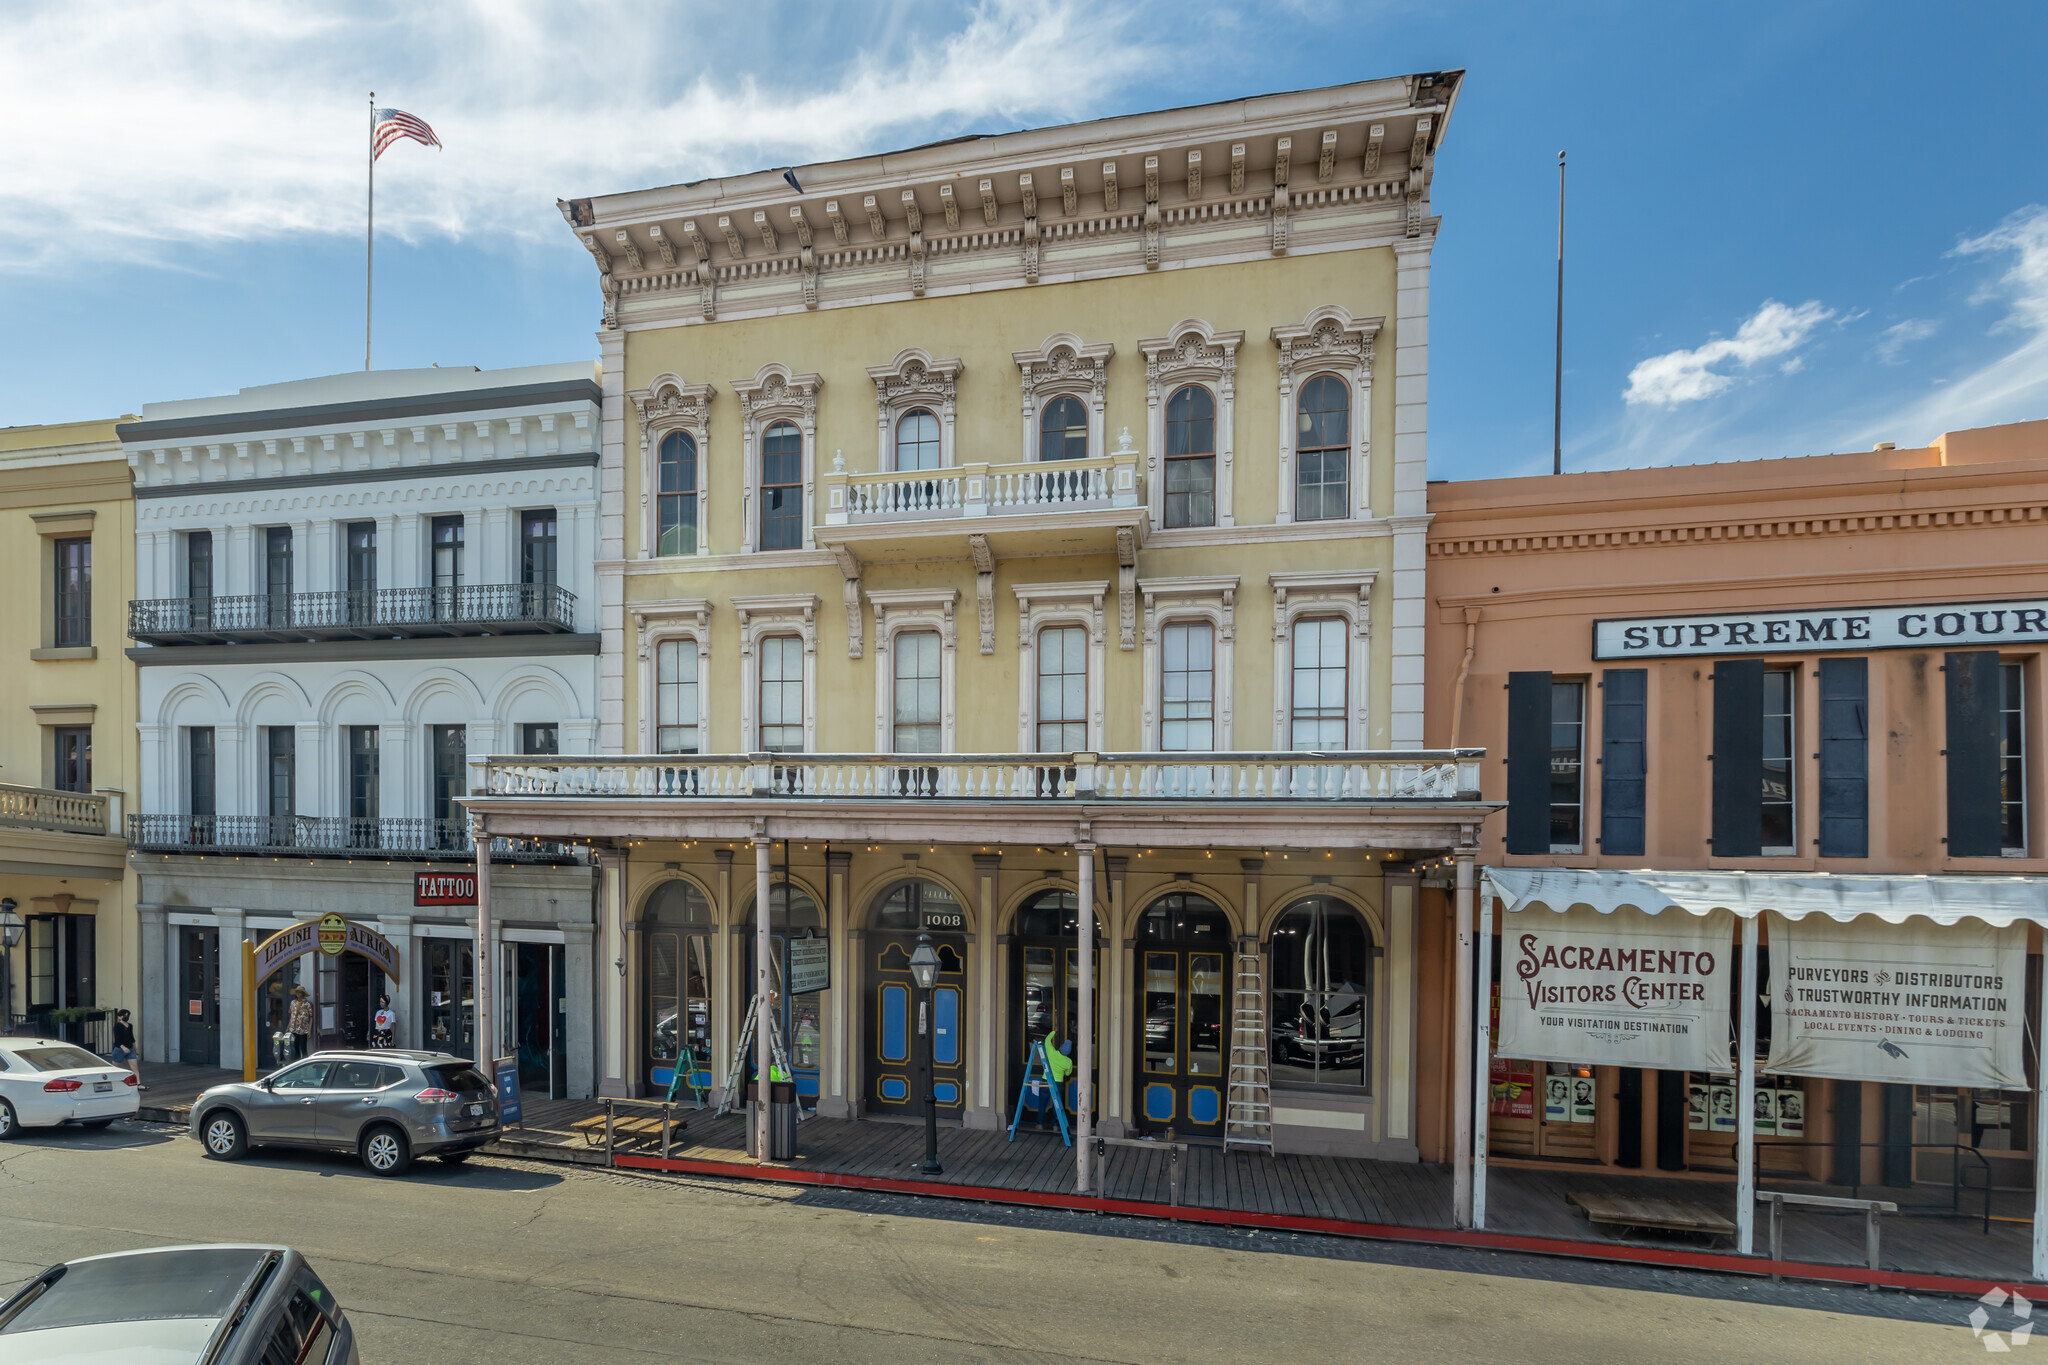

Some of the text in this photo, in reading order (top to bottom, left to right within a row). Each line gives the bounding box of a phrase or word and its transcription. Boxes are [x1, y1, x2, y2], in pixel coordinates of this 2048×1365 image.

[1623, 615, 1870, 650] SUPREME
[418, 877, 474, 897] TATTOO
[927, 915, 961, 926] 1008
[264, 926, 312, 964] LIBUSH
[350, 927, 392, 964] AFRICA
[1516, 933, 1715, 981] SACRAMENTO
[1788, 967, 1869, 983] PURVEYORS
[1895, 971, 2003, 990] DISTRIBUTORS
[1525, 979, 1616, 1011] VISITORS
[1622, 976, 1705, 1010] CENTER
[1798, 988, 1900, 1006] TRUSTWORTHY
[1906, 993, 2007, 1012] INFORMATION
[1540, 1016, 1688, 1034] YOUR VISITATION DESTINATION
[1785, 1008, 2006, 1028] SACRAMENTO HISTORY TOURS & TICKETS
[1804, 1021, 1984, 1040] LOCAL EVENTS DINING & LODGING
